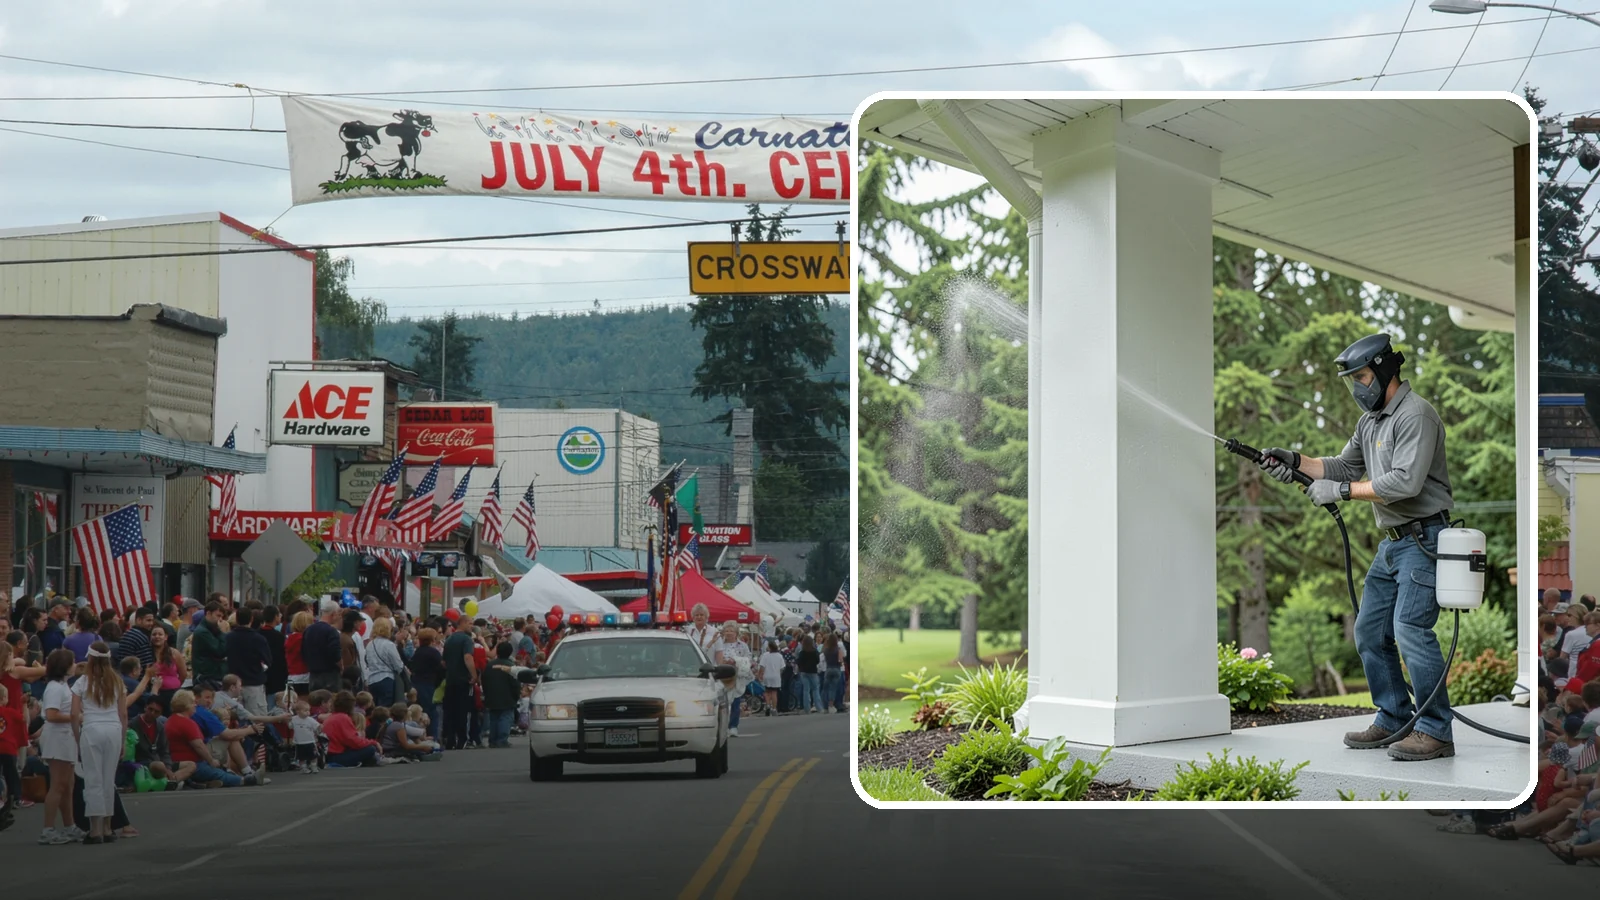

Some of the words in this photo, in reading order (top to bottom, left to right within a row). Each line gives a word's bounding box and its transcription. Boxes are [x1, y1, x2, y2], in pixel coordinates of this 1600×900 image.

[695, 121, 850, 150] Carnat
[481, 141, 605, 192] JULY
[632, 150, 746, 198] 4th.
[697, 254, 850, 280] CROSSWA
[282, 380, 374, 420] ACE
[405, 409, 452, 422] CEDAR
[461, 409, 485, 421] LOG
[283, 421, 371, 436] Hardware
[416, 428, 477, 447] Coca-Cola
[353, 467, 386, 480] Simpl
[83, 486, 94, 494] St.
[96, 485, 124, 495] Vincent
[126, 486, 136, 495] de
[138, 486, 155, 495] Paul
[688, 526, 741, 535] CRNATION
[699, 535, 730, 543] GLASS
